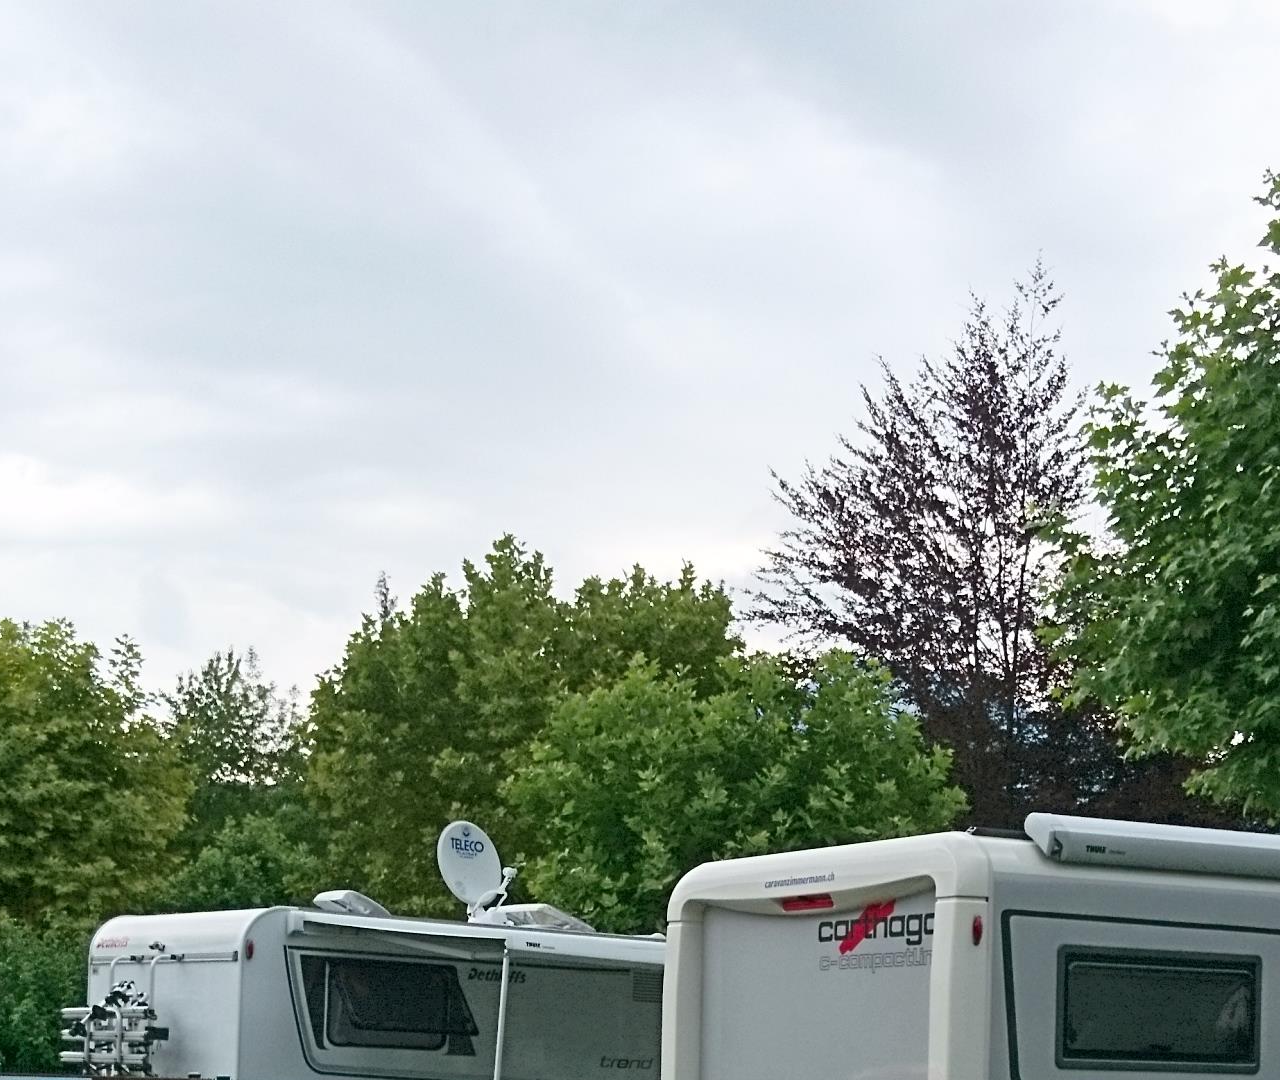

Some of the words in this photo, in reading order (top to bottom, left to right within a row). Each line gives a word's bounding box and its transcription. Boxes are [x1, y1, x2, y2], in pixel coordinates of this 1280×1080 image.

[451, 837, 484, 853] TELECO
[1086, 845, 1106, 854] THULE
[764, 872, 835, 888] caravanzimmermann.ch
[468, 967, 526, 984] Dethlffs
[599, 1055, 654, 1070] trend
